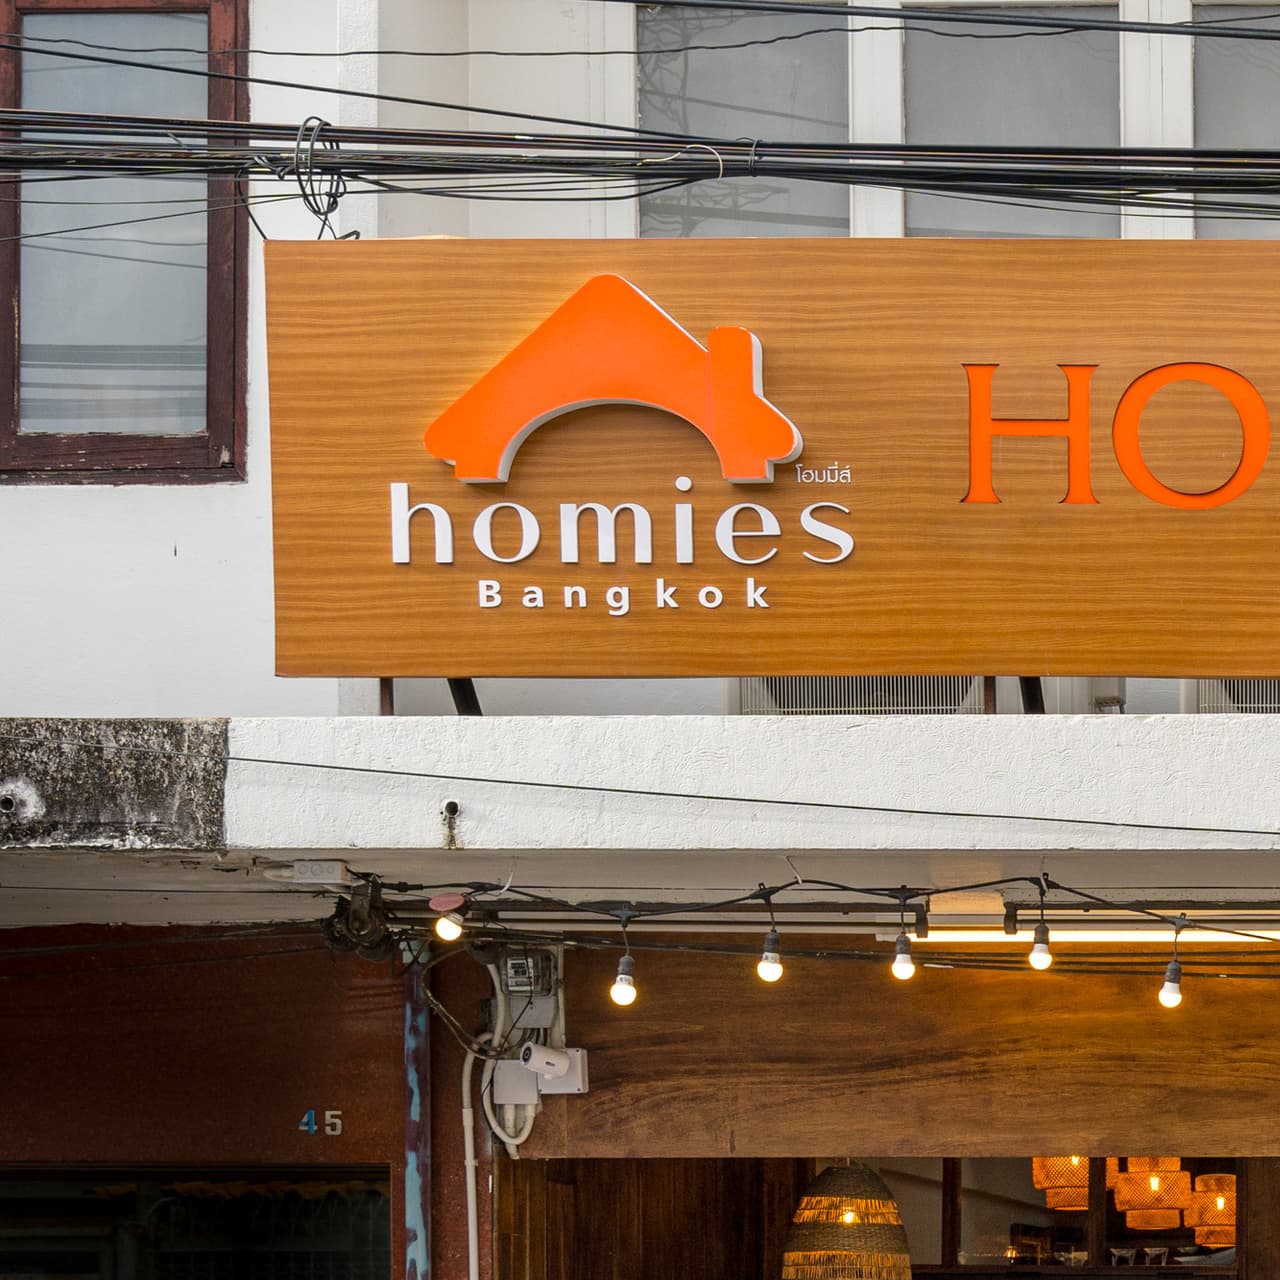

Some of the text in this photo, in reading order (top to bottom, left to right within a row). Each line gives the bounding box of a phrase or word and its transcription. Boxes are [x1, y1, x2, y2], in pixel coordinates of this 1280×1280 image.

[795, 461, 851, 483] โฮมมี่ส์
[390, 475, 855, 565] homies
[478, 577, 770, 616] Bangkok
[298, 1109, 343, 1136] 45
